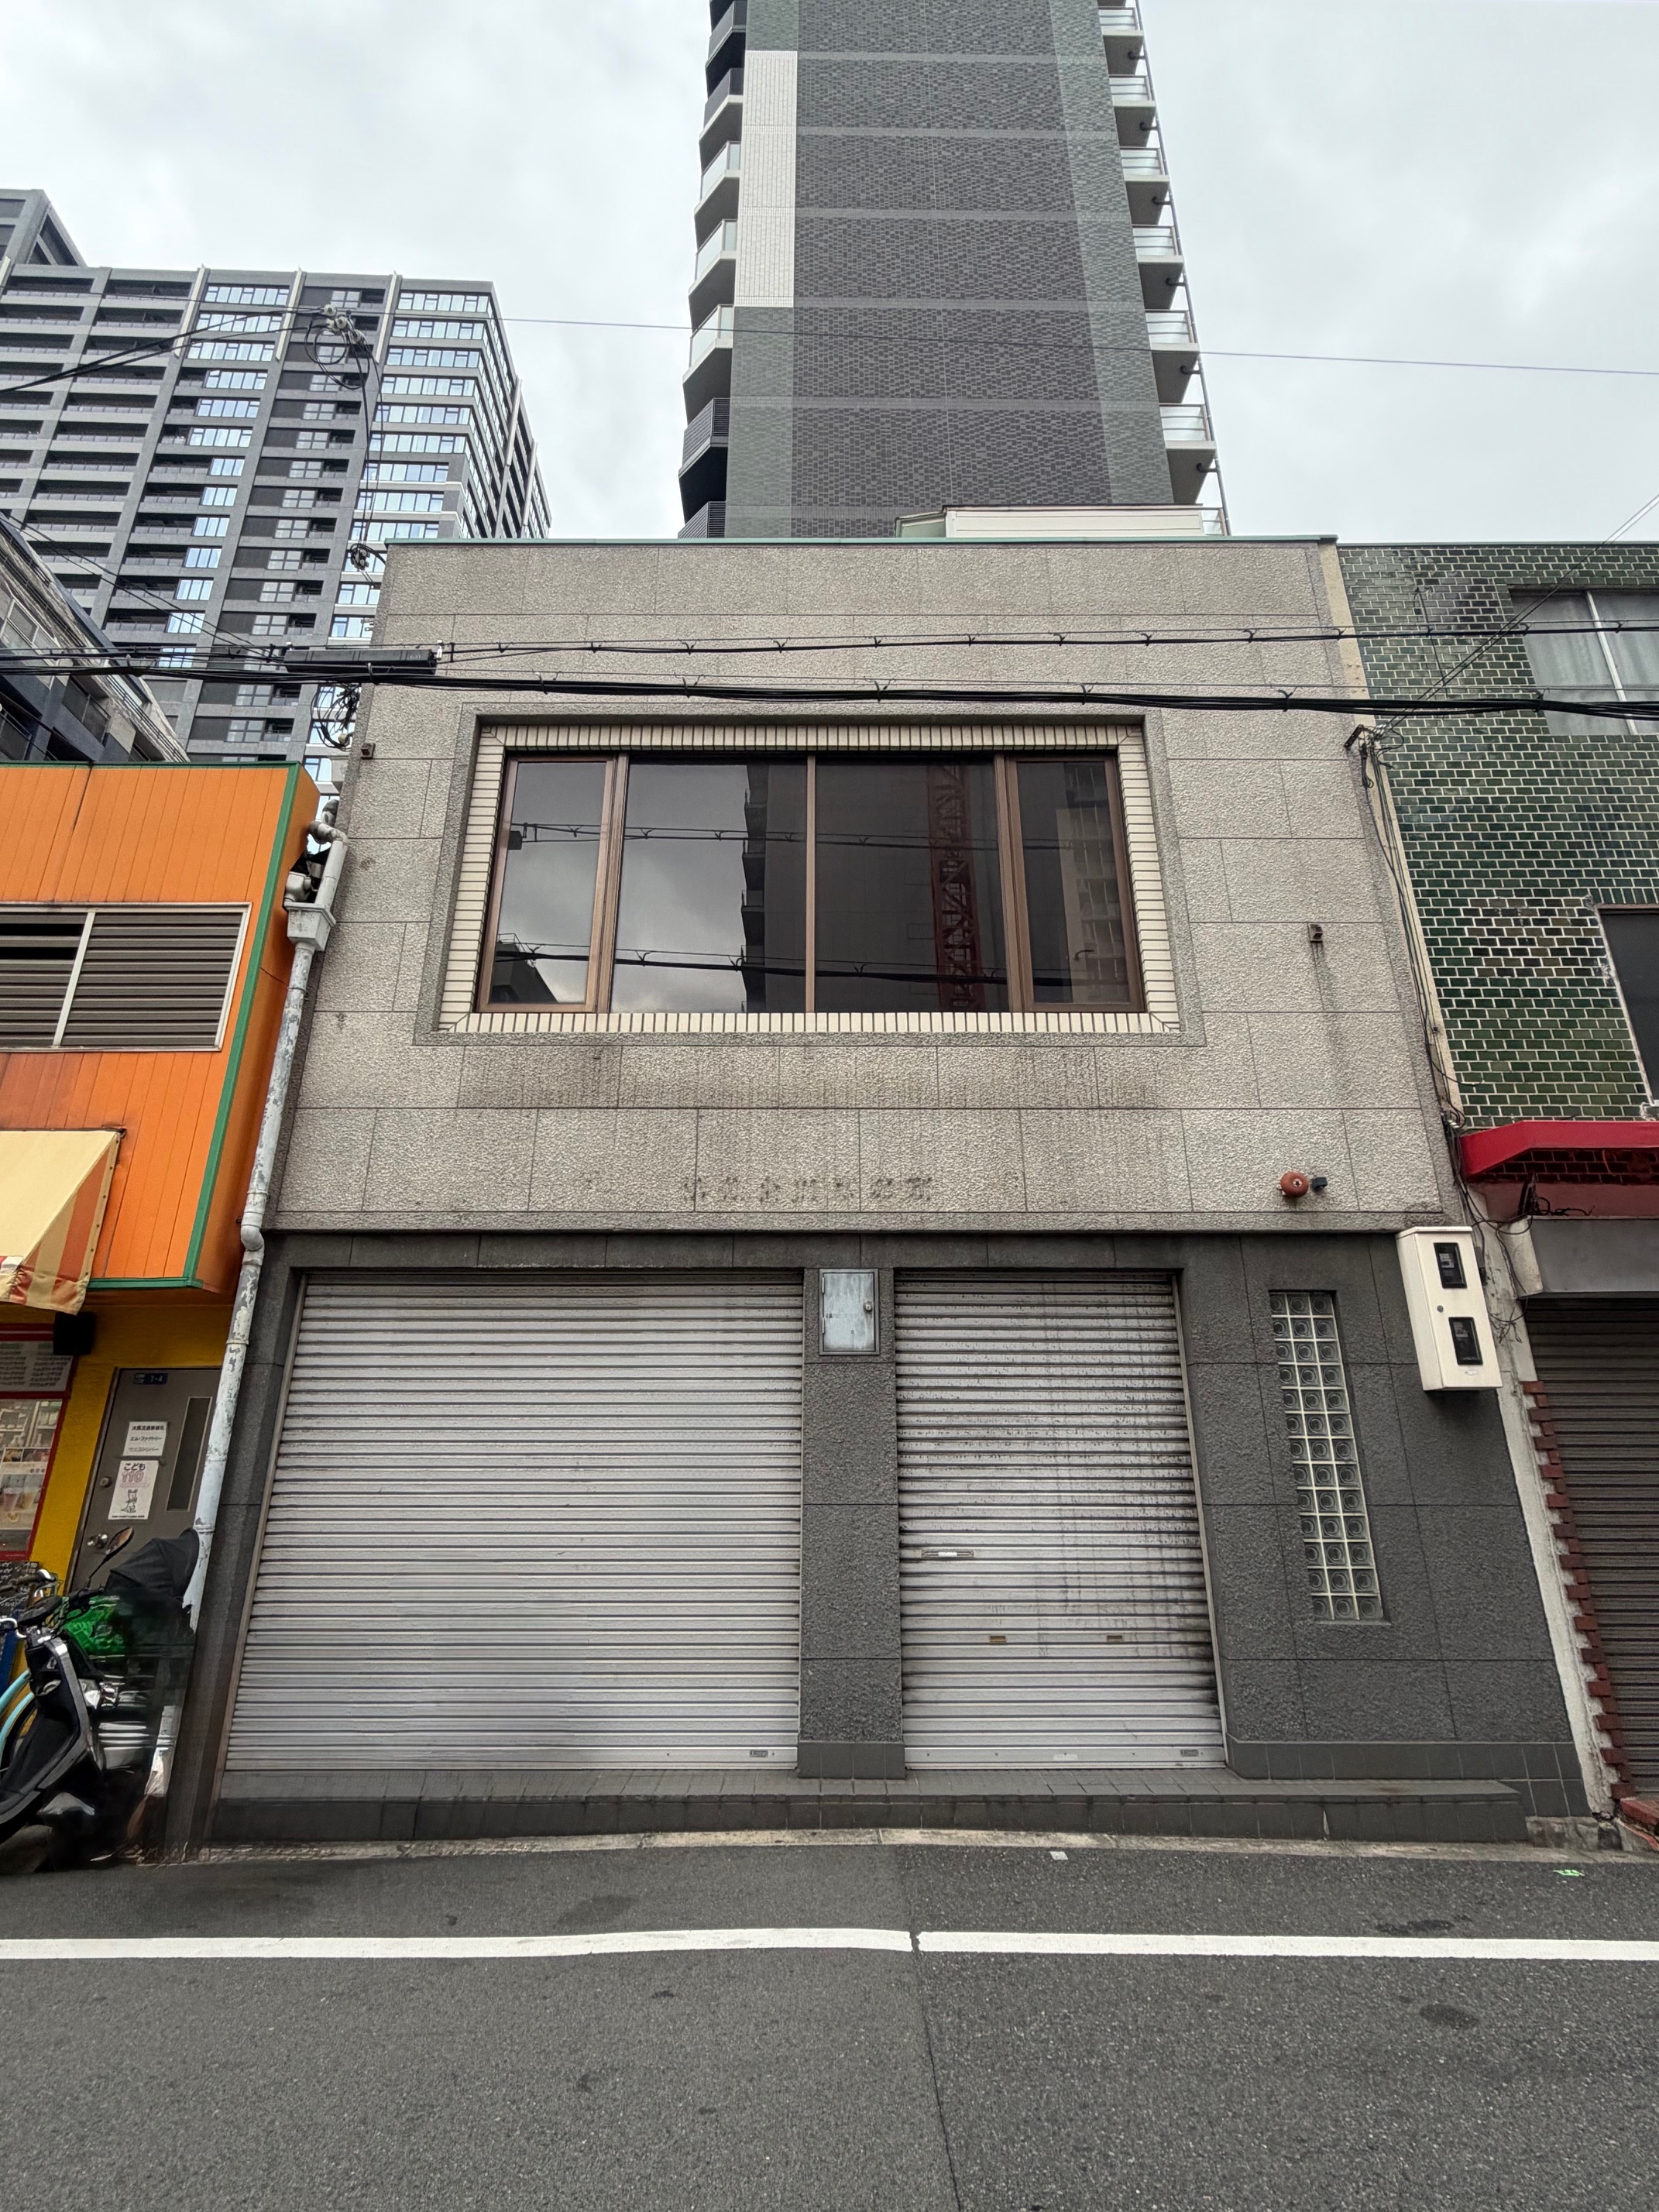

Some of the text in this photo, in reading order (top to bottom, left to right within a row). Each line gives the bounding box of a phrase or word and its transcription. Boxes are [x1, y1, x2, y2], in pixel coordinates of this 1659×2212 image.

[124, 1462, 146, 1471] こども
[122, 1470, 144, 1482] 110
